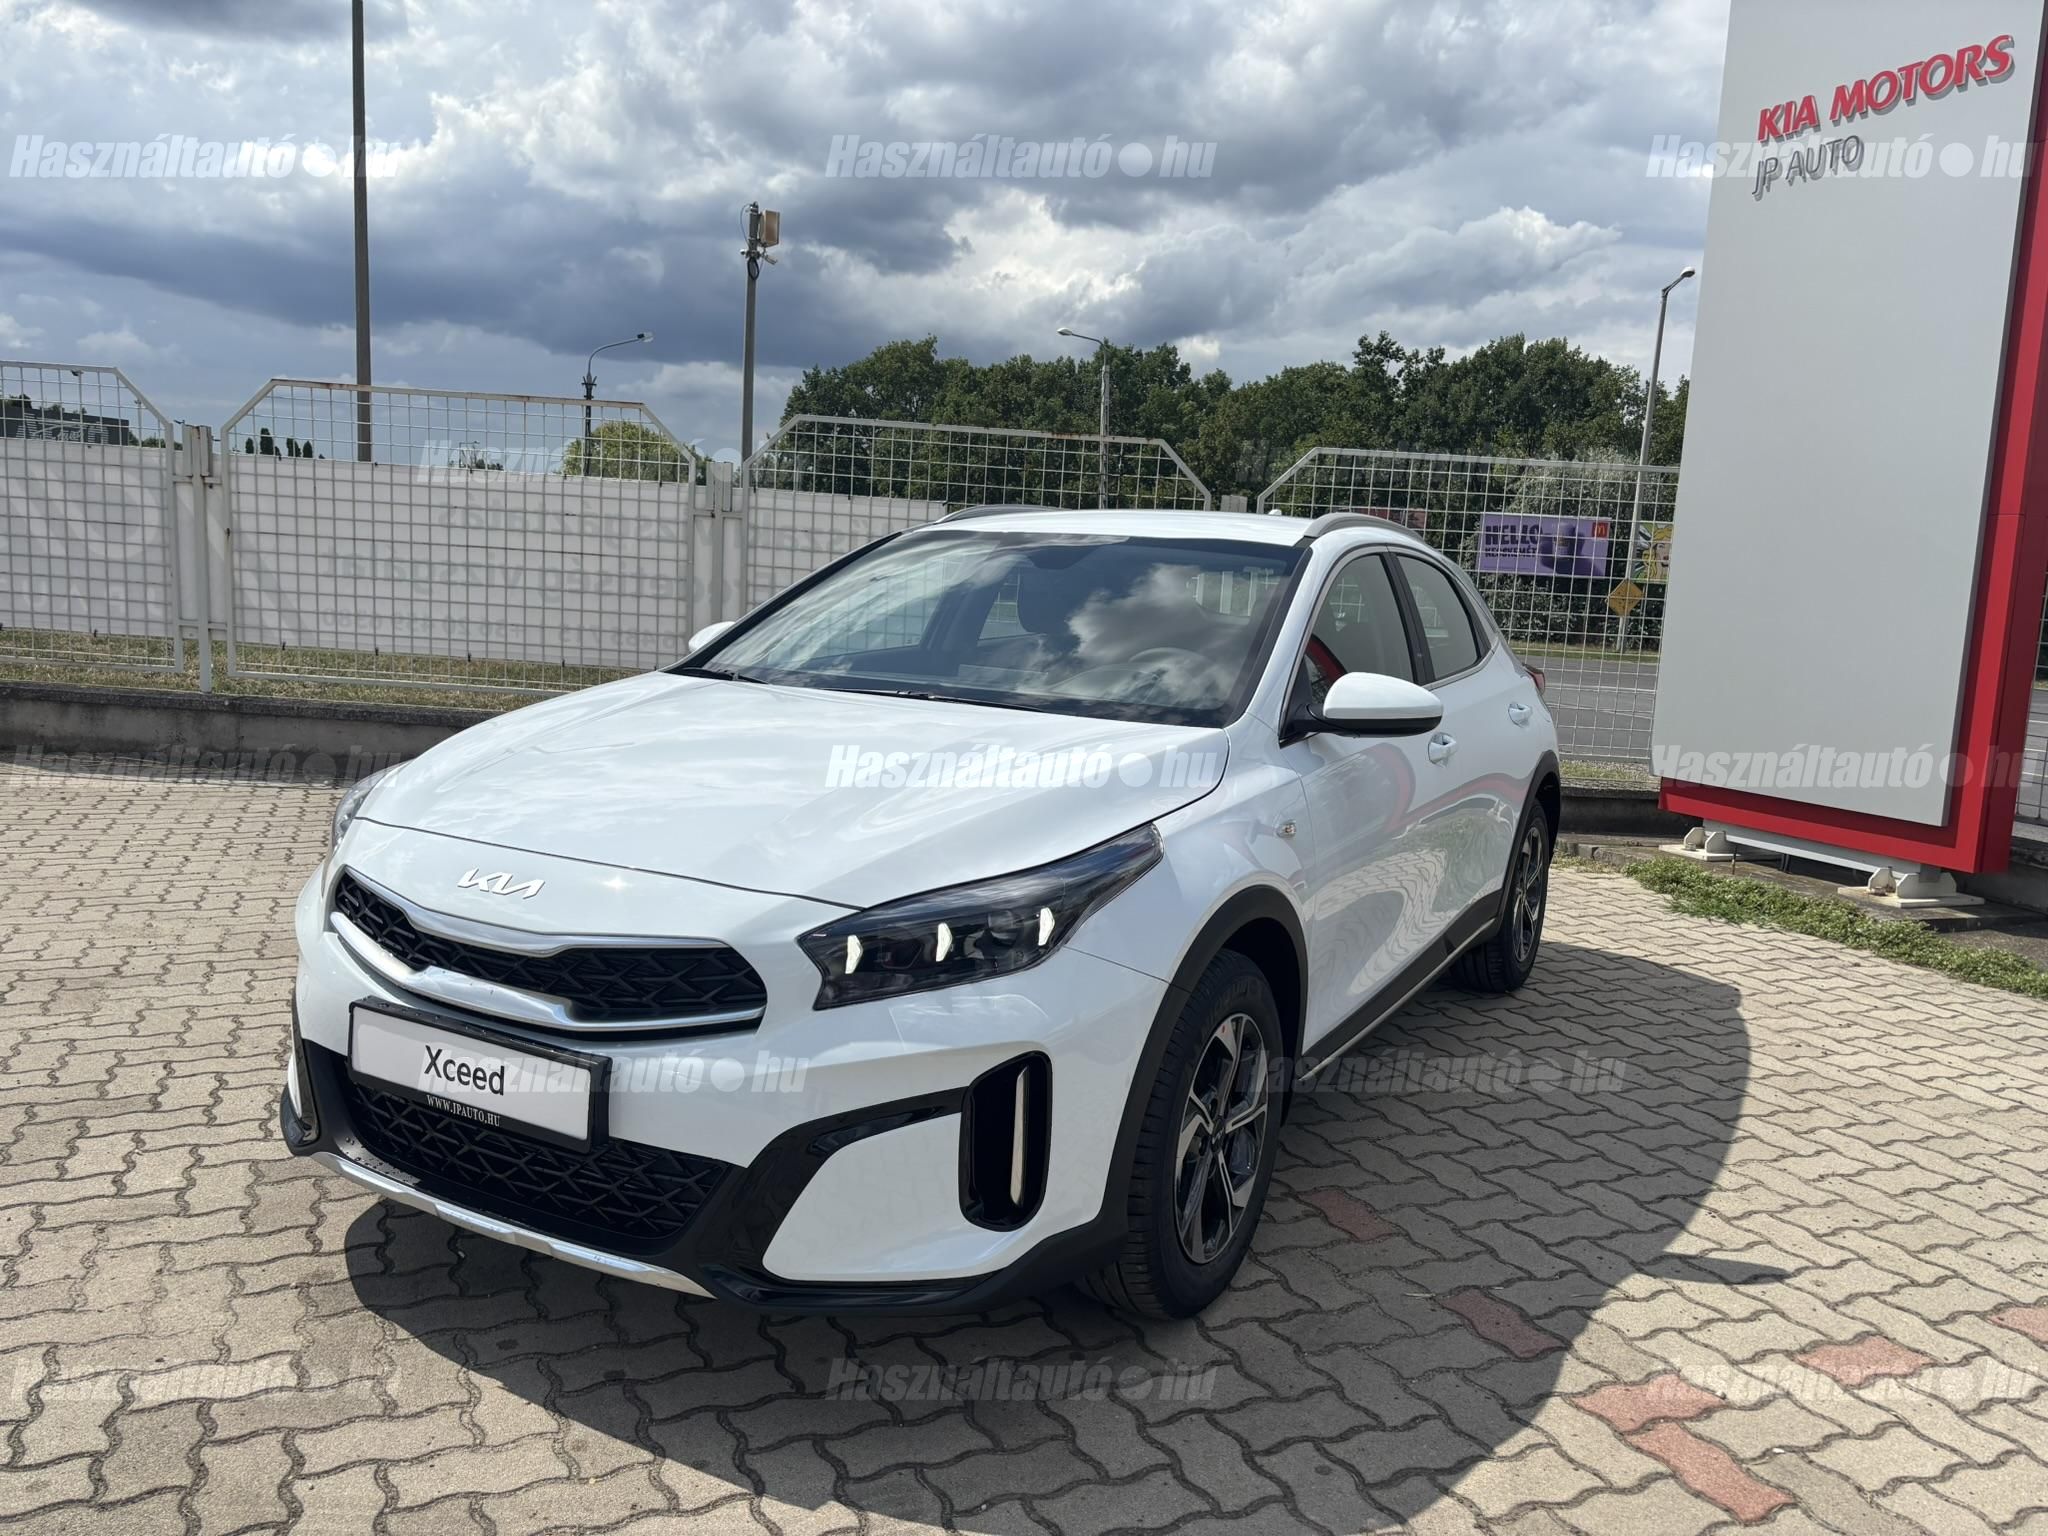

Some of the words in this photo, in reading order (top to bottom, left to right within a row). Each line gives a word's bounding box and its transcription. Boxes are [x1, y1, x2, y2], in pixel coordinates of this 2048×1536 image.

[1757, 95, 1819, 143] KIA
[1829, 34, 2014, 121] MOTORS
[1752, 156, 1779, 197] JP
[1785, 134, 1864, 184] AUTO
[1485, 523, 1542, 546] HELLO
[424, 1045, 505, 1097] Xceed
[426, 1094, 500, 1127] WWW.JPAUTO.HU
